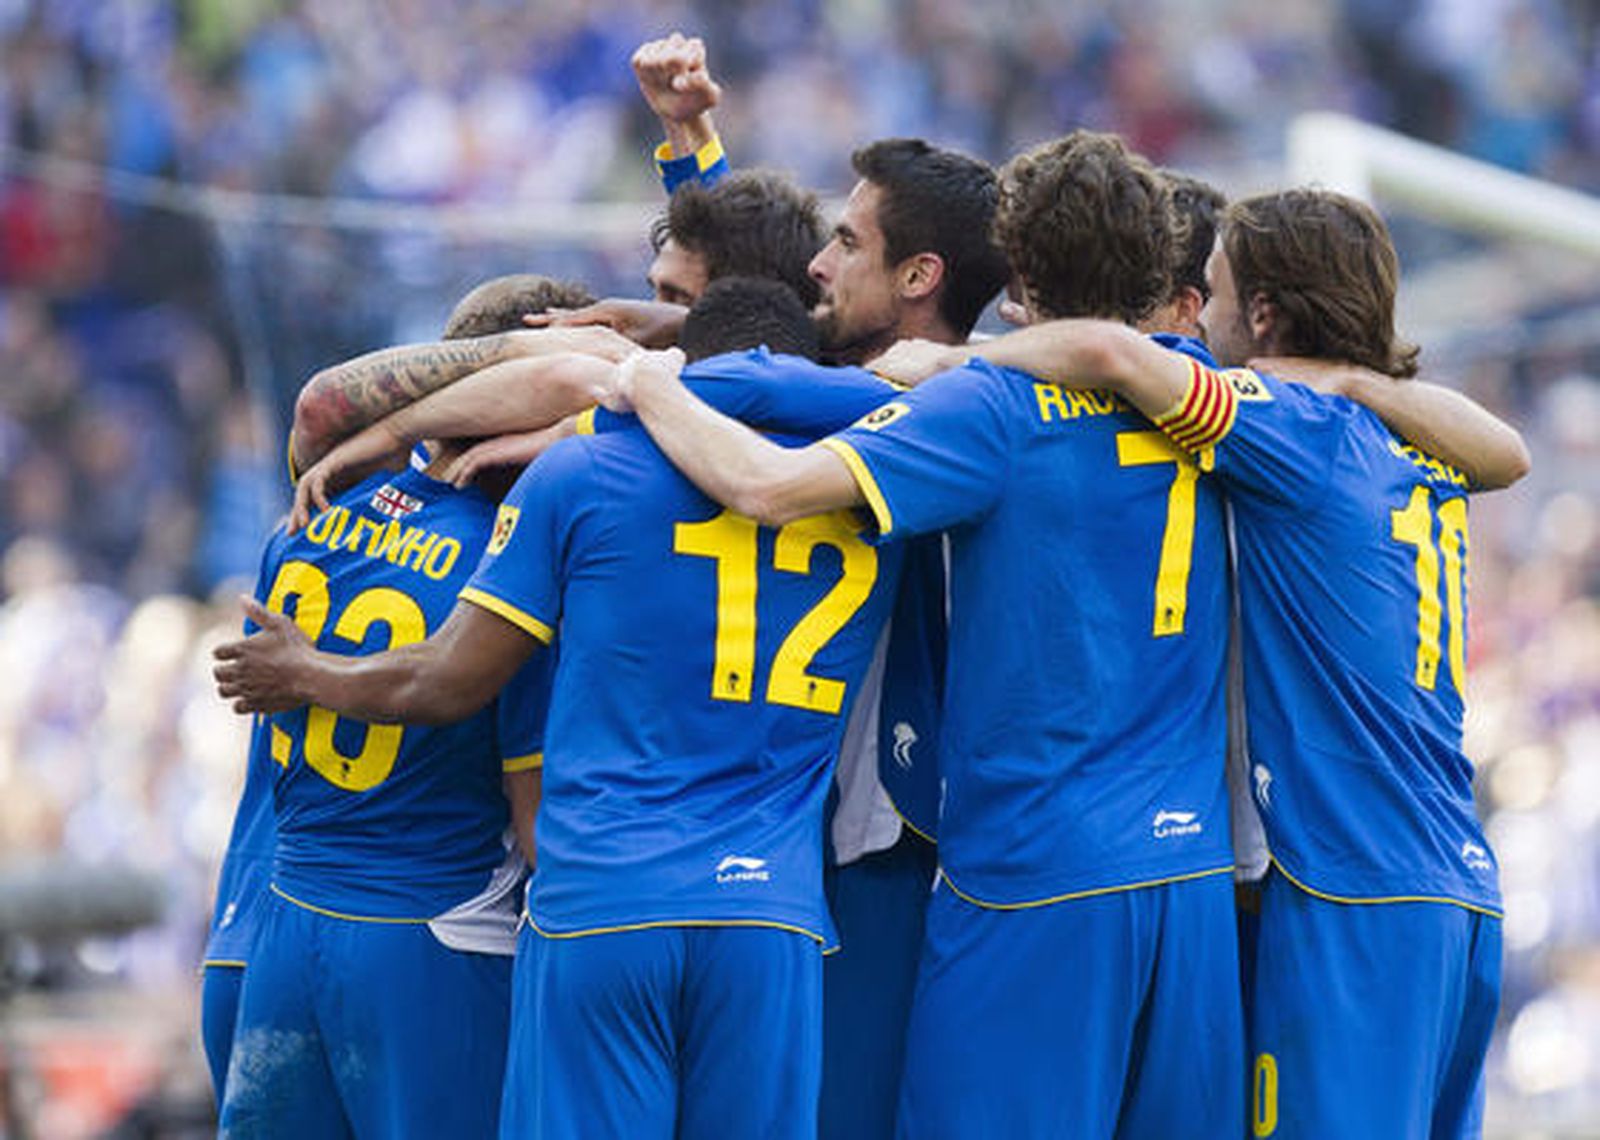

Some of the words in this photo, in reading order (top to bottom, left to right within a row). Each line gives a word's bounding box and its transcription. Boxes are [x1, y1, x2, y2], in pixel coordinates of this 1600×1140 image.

[1033, 383, 1128, 422] RAU
[306, 505, 462, 580] OUTINHO
[1116, 431, 1199, 636] 7
[1391, 484, 1468, 700] 10
[673, 508, 878, 714] 12
[1253, 1053, 1278, 1137] 0
